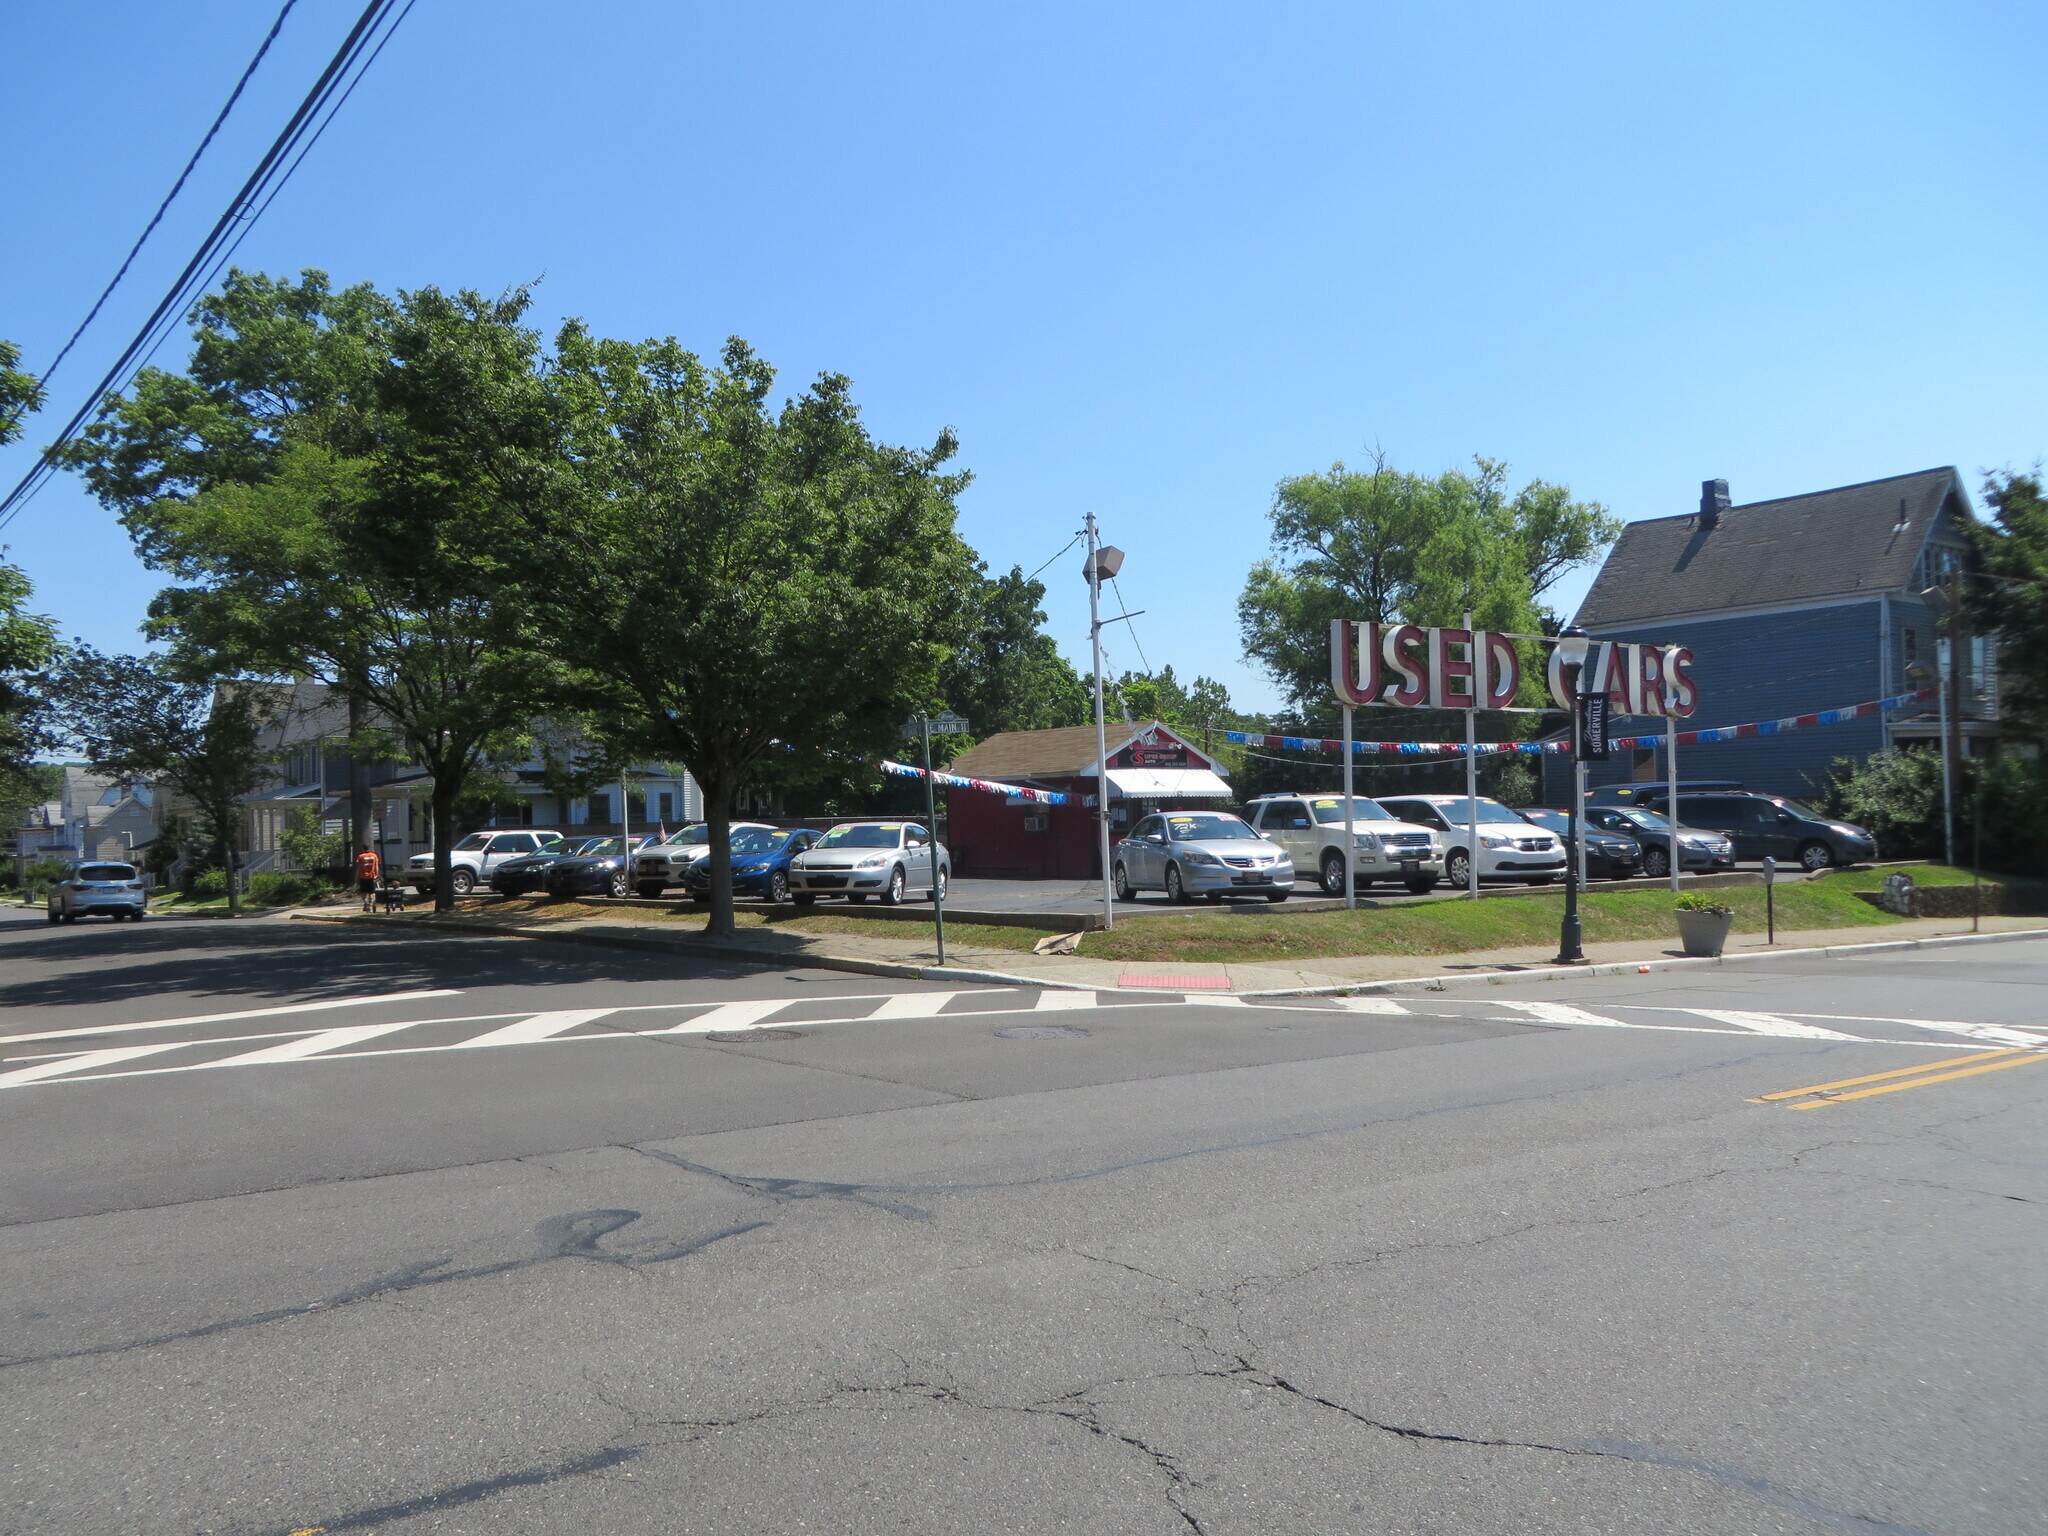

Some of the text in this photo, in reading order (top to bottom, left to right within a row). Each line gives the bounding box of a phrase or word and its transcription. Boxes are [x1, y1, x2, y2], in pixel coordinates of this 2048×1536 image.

[1331, 619, 1520, 709] USED
[938, 723, 957, 733] MAIN
[1592, 698, 1603, 753] SOMERVILLE
